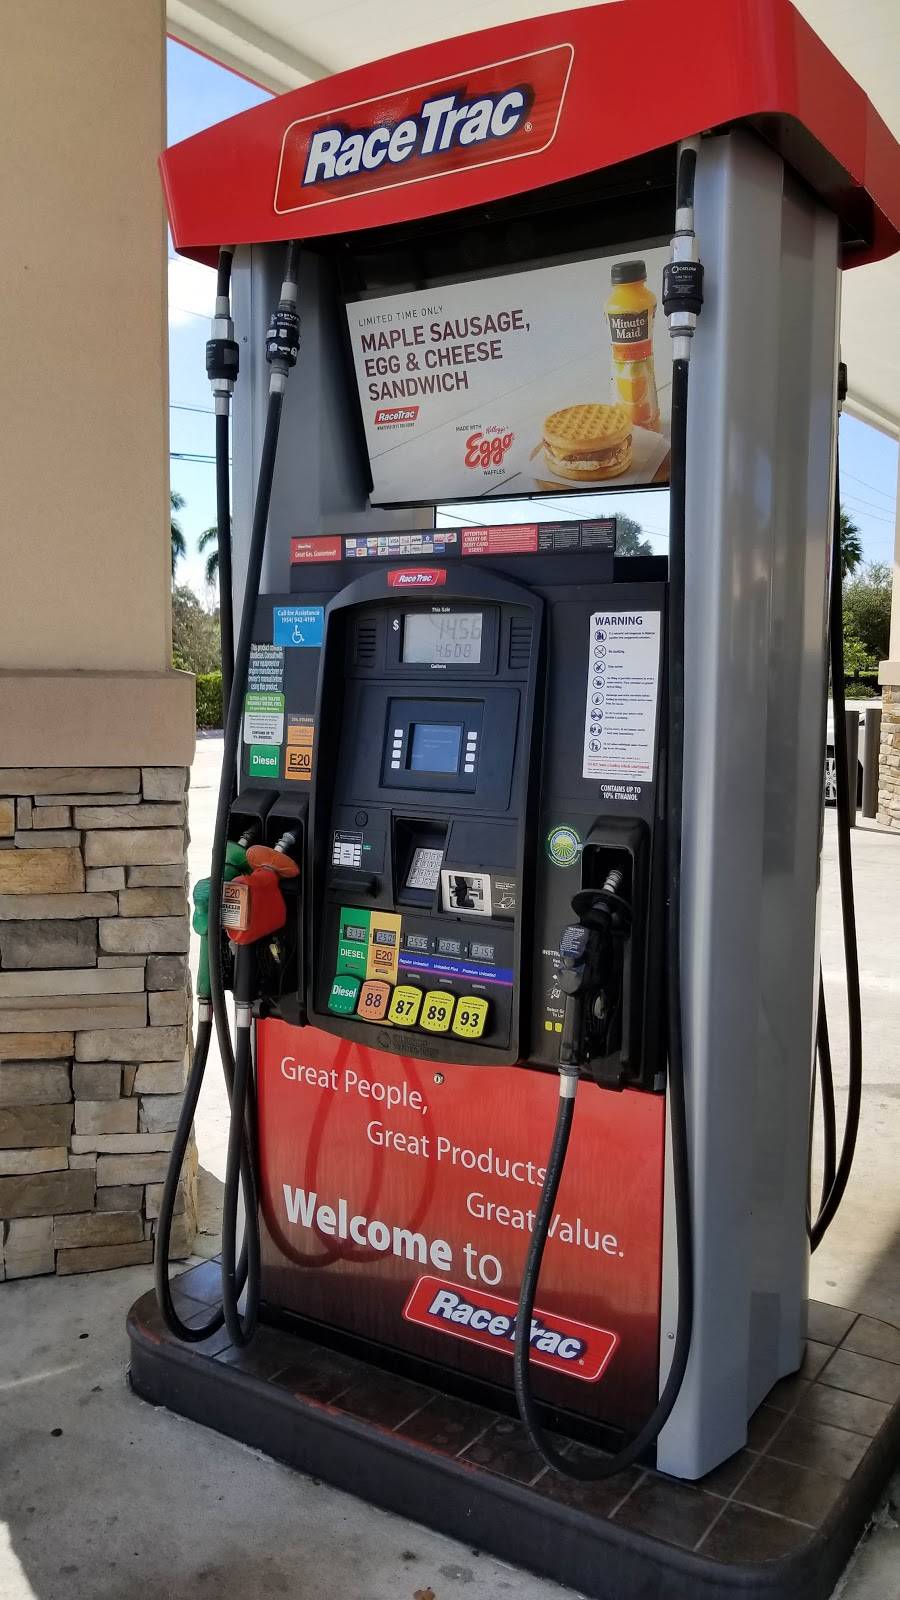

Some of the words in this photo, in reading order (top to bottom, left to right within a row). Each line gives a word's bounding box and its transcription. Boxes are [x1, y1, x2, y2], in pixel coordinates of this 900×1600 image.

[302, 91, 525, 185] RaceTrac
[358, 314, 393, 327] LIMITED
[396, 309, 418, 321] TIME
[421, 305, 444, 317] ONLY
[611, 317, 646, 329] Minute
[360, 325, 426, 353] MAPLE
[429, 309, 531, 343] SAUSAGE,
[616, 328, 641, 339] Maid
[364, 354, 401, 378] EGG
[406, 352, 421, 372] &
[424, 339, 503, 369] CHEESE
[368, 370, 469, 402] SANDWICH
[377, 410, 416, 422] RaceTrac
[470, 424, 482, 432] WITH
[464, 432, 514, 469] Eggo
[484, 468, 506, 476] WAFFLES
[398, 574, 433, 584] RaceTrac
[392, 618, 400, 632] $
[594, 616, 643, 626] WARNING
[252, 756, 277, 766] Diesel
[290, 753, 310, 766] E20
[600, 784, 626, 793] CONTAINS
[634, 786, 642, 794] TO
[614, 792, 638, 801] ETHANOL
[224, 888, 240, 899] E20
[340, 948, 366, 960] DIESEL
[375, 950, 393, 962] E20
[332, 984, 357, 998] Diesel
[364, 992, 382, 1008] 88
[395, 1000, 415, 1016] 87
[427, 1005, 446, 1022] 89
[460, 1011, 480, 1028] 93
[280, 1056, 338, 1092] Great
[345, 1070, 429, 1115] People,
[366, 1120, 430, 1159] Great
[437, 1136, 547, 1188] Products
[466, 1192, 537, 1233] Great
[282, 1184, 452, 1271] Welcome
[464, 1242, 502, 1286] to
